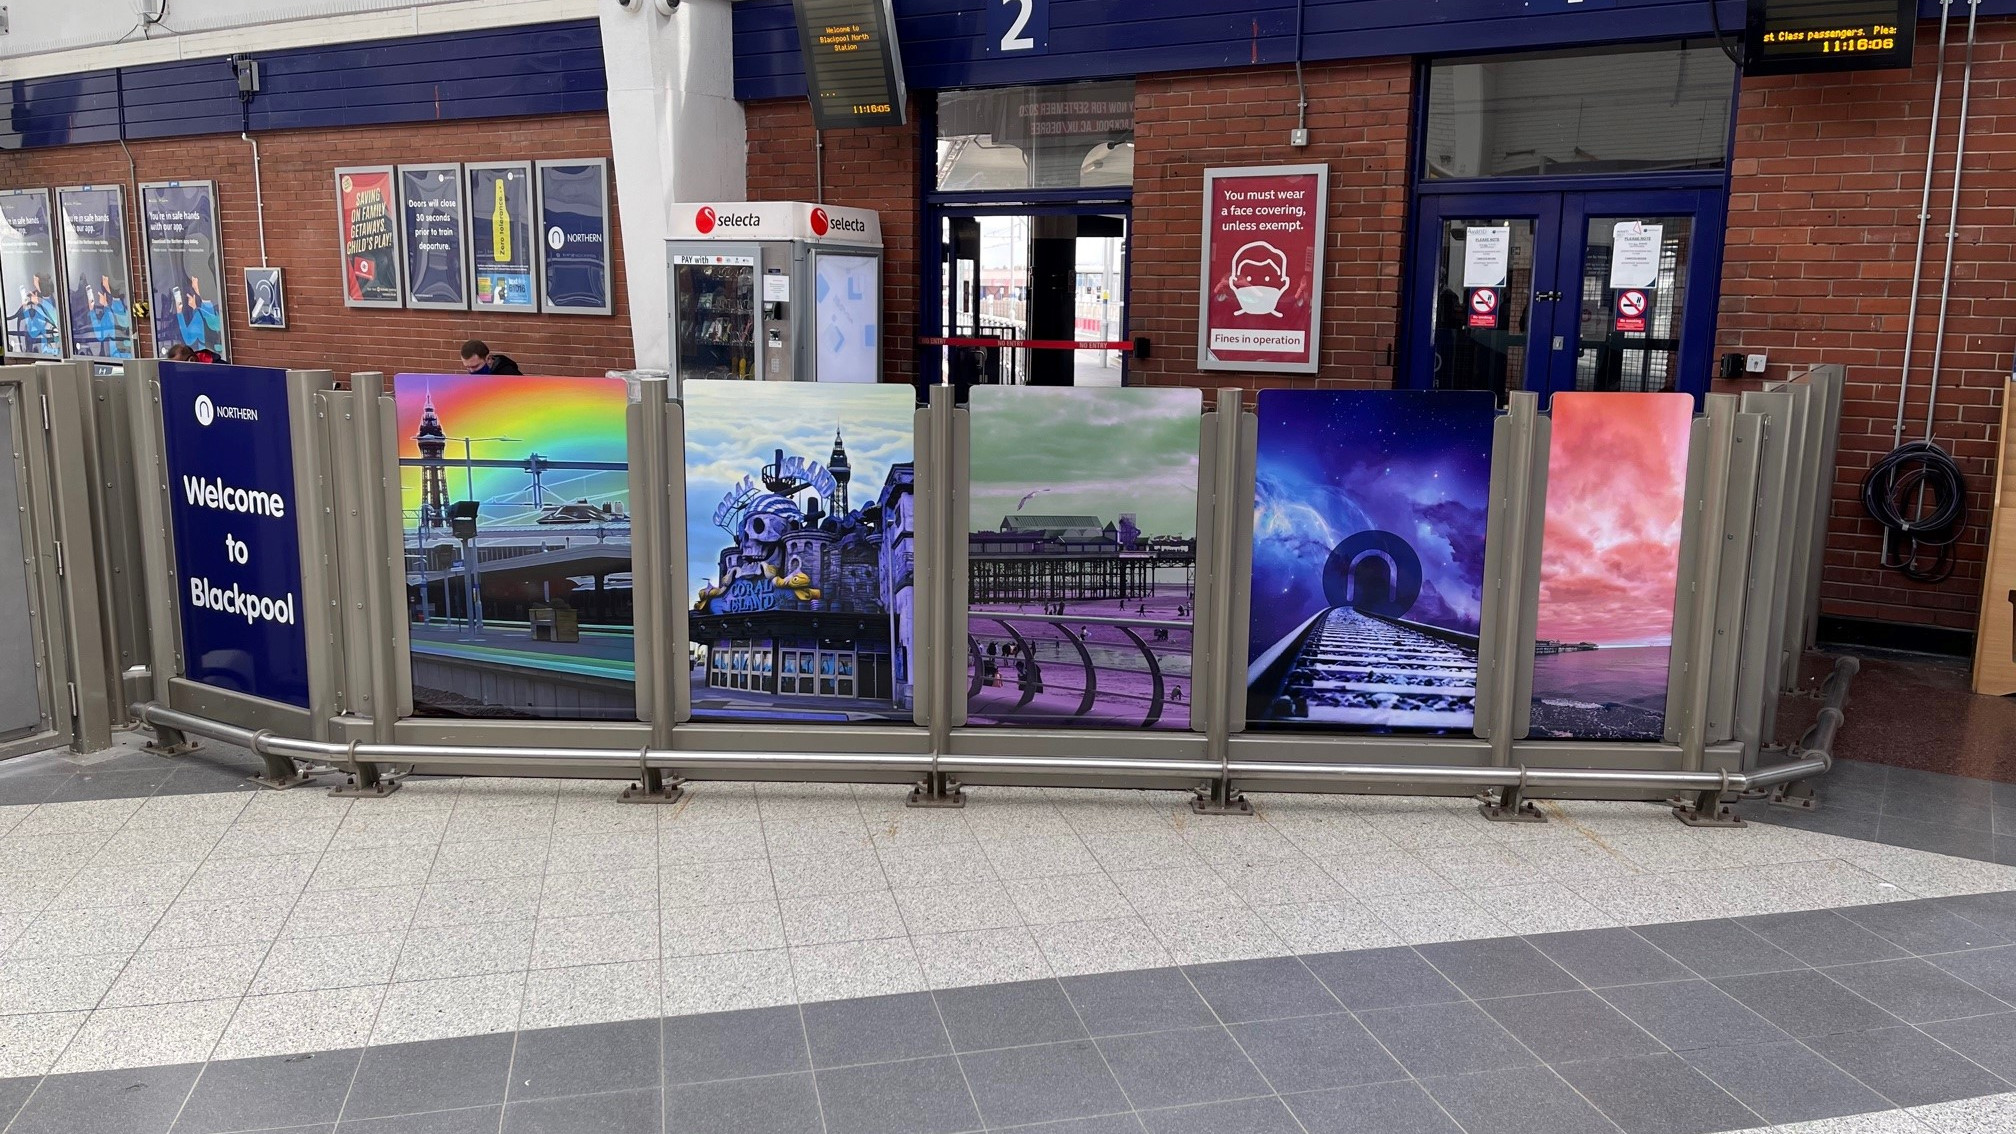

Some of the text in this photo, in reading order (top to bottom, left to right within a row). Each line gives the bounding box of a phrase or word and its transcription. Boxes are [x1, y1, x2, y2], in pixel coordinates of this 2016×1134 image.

[826, 26, 850, 34] Welcome
[1000, 0, 1034, 50] 2
[819, 35, 850, 44] Blackpool
[1778, 32, 1804, 41] Class
[1807, 28, 1866, 41] passengers.
[1823, 38, 1894, 52] 11:16:06
[853, 104, 891, 114] 11:16:05
[356, 188, 381, 206] SAVING
[1224, 189, 1305, 201] You must wear
[408, 199, 456, 208] Doors will close
[149, 211, 200, 220] You're in safe hands
[352, 202, 386, 223] ON FAMILY
[1221, 204, 1306, 218] a face covering,
[94, 214, 110, 222] hands
[416, 214, 451, 222] 30 seconds
[717, 213, 760, 227] selecta
[830, 217, 865, 232] selecta
[150, 222, 162, 230] with
[173, 223, 184, 232] app.
[351, 218, 386, 239] GETAWAYS.
[415, 228, 453, 238] prior to train
[1222, 220, 1304, 233] unless exempt.
[347, 232, 392, 255] CHILD'S PLAY!
[567, 234, 602, 242] NORTHERN
[419, 242, 451, 251] departure.
[694, 256, 709, 264] with
[1215, 334, 1300, 347] Fines in operation
[217, 406, 258, 421] NORTHERN
[183, 474, 284, 518] Welcome
[225, 532, 248, 565] to
[730, 579, 773, 598] CORAL
[190, 577, 294, 625] Blackpool
